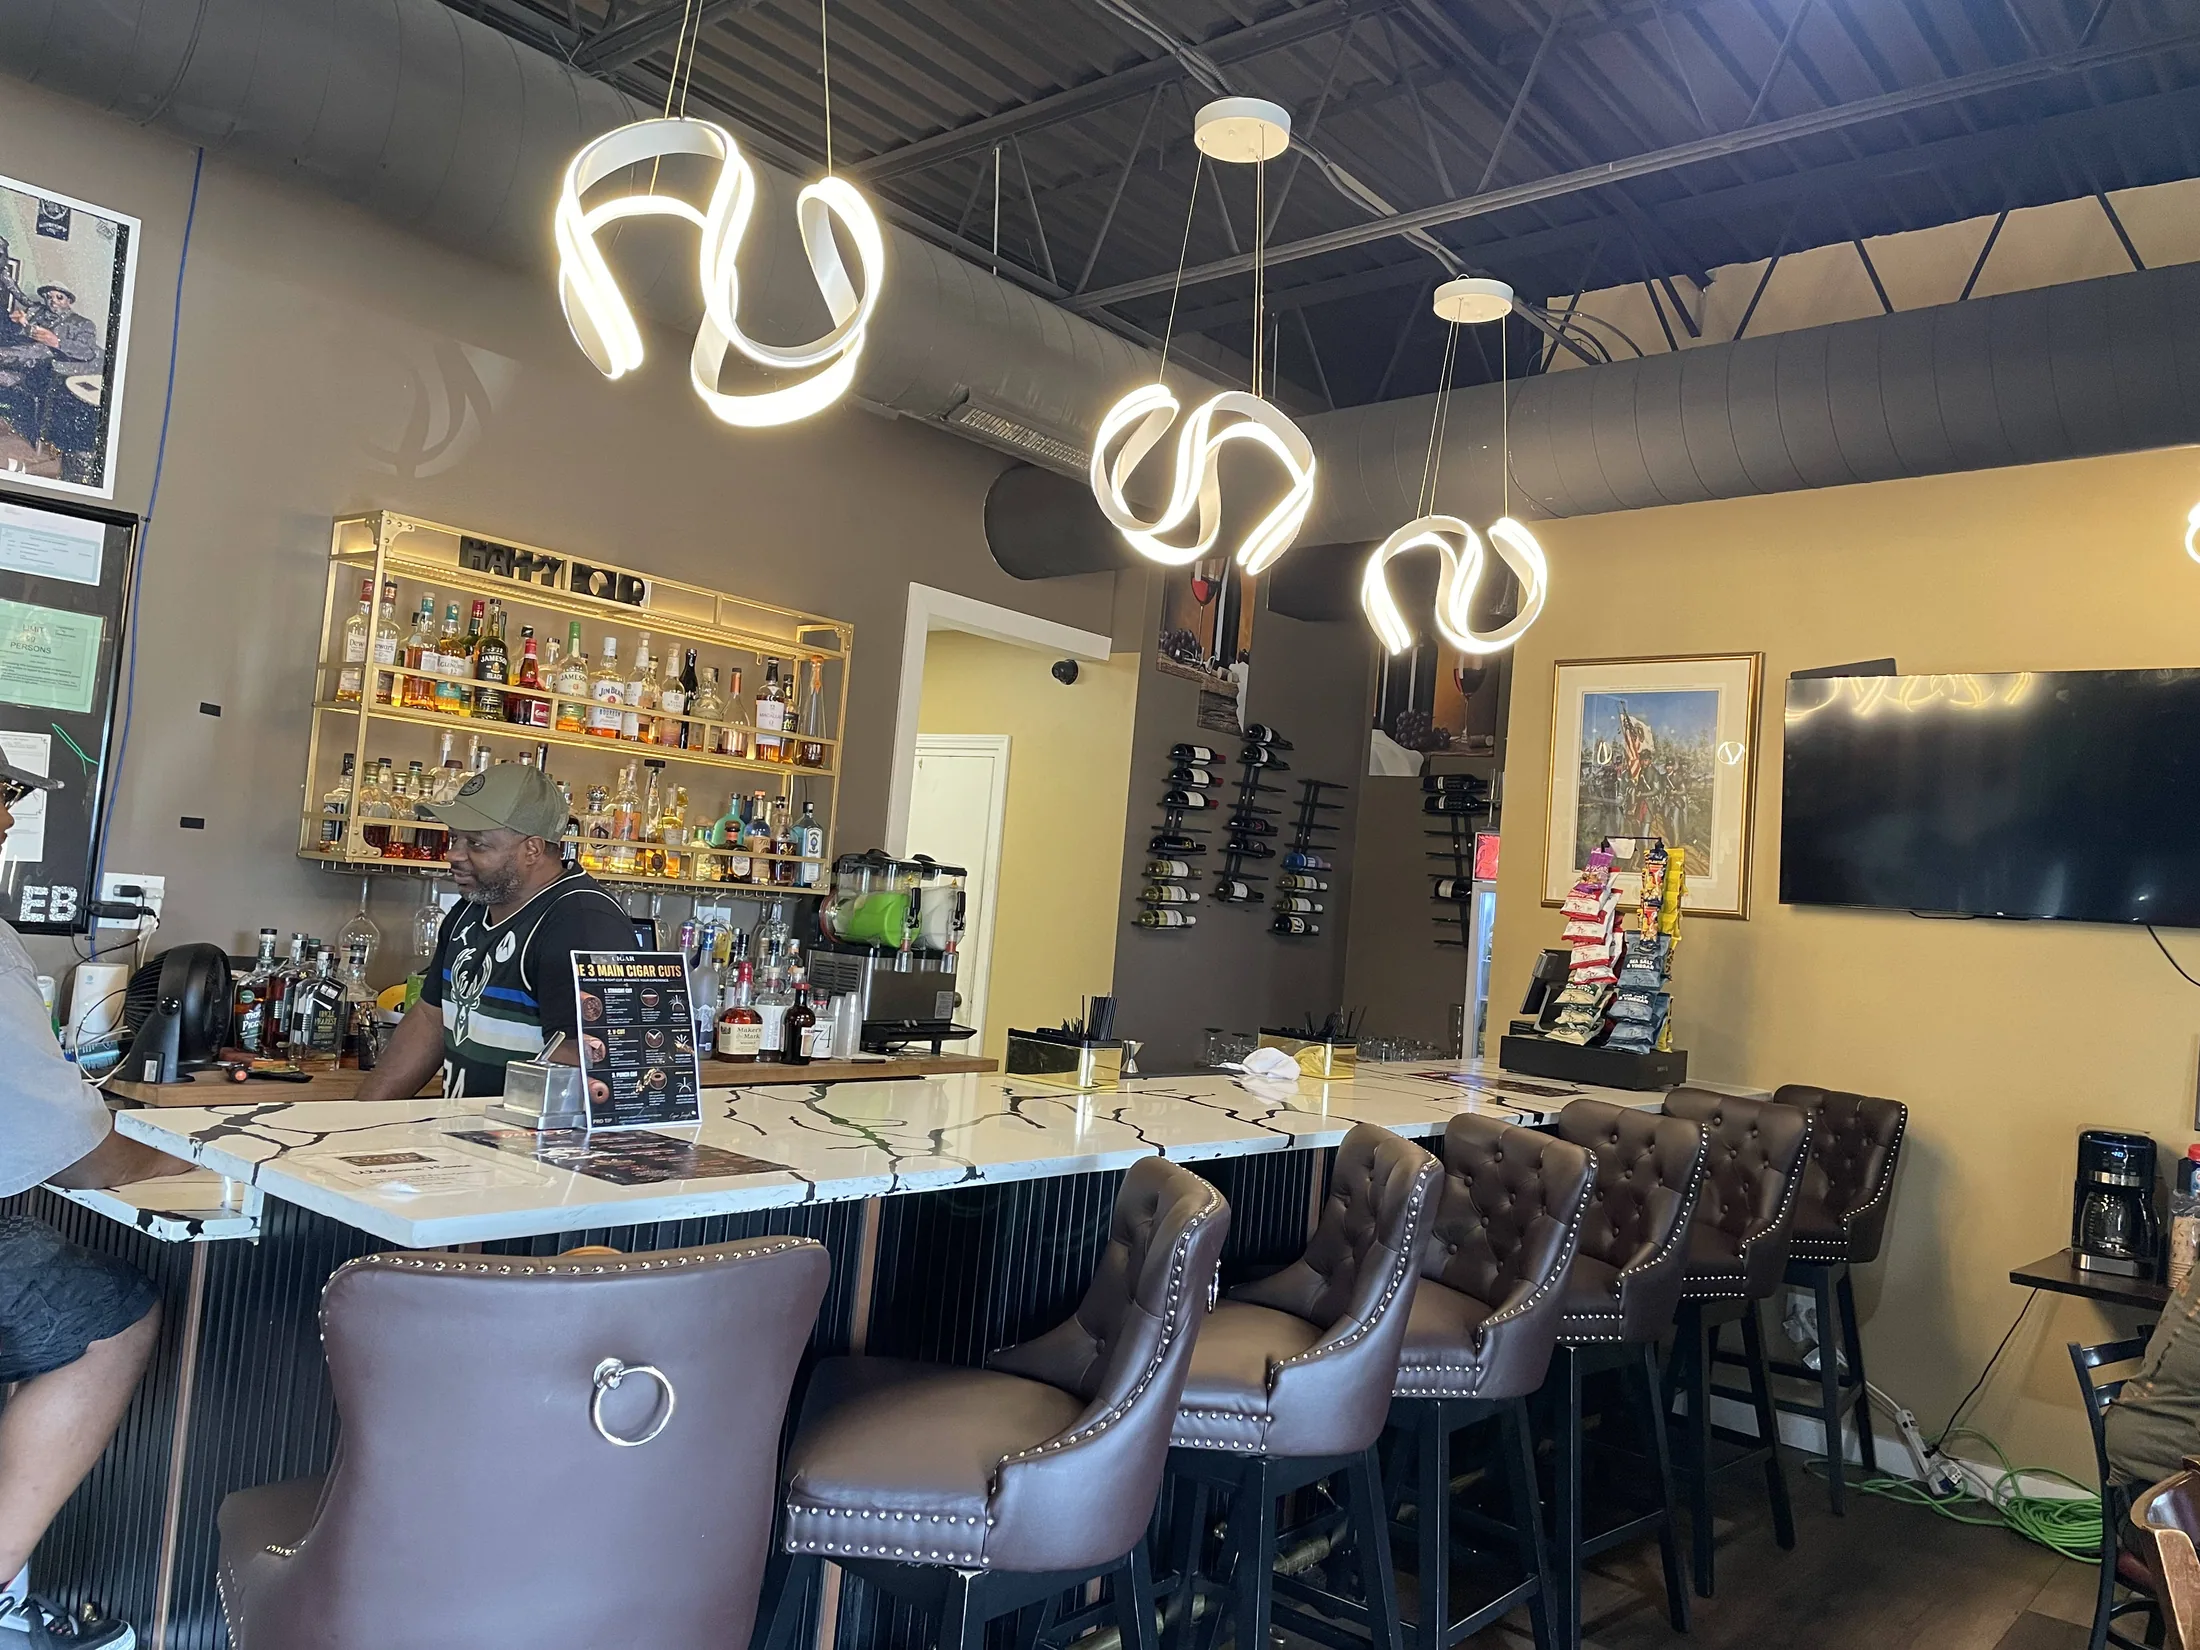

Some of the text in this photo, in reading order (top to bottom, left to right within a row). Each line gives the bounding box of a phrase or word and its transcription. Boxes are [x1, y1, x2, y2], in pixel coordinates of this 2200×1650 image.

[22, 624, 44, 633] LIMIT
[10, 641, 52, 655] PERSONS
[19, 885, 78, 923] EB
[587, 964, 596, 977] 3
[597, 964, 625, 977] MAIN
[625, 965, 656, 977] CIGAR
[657, 965, 682, 977] CUTS
[811, 1025, 832, 1049] 74
